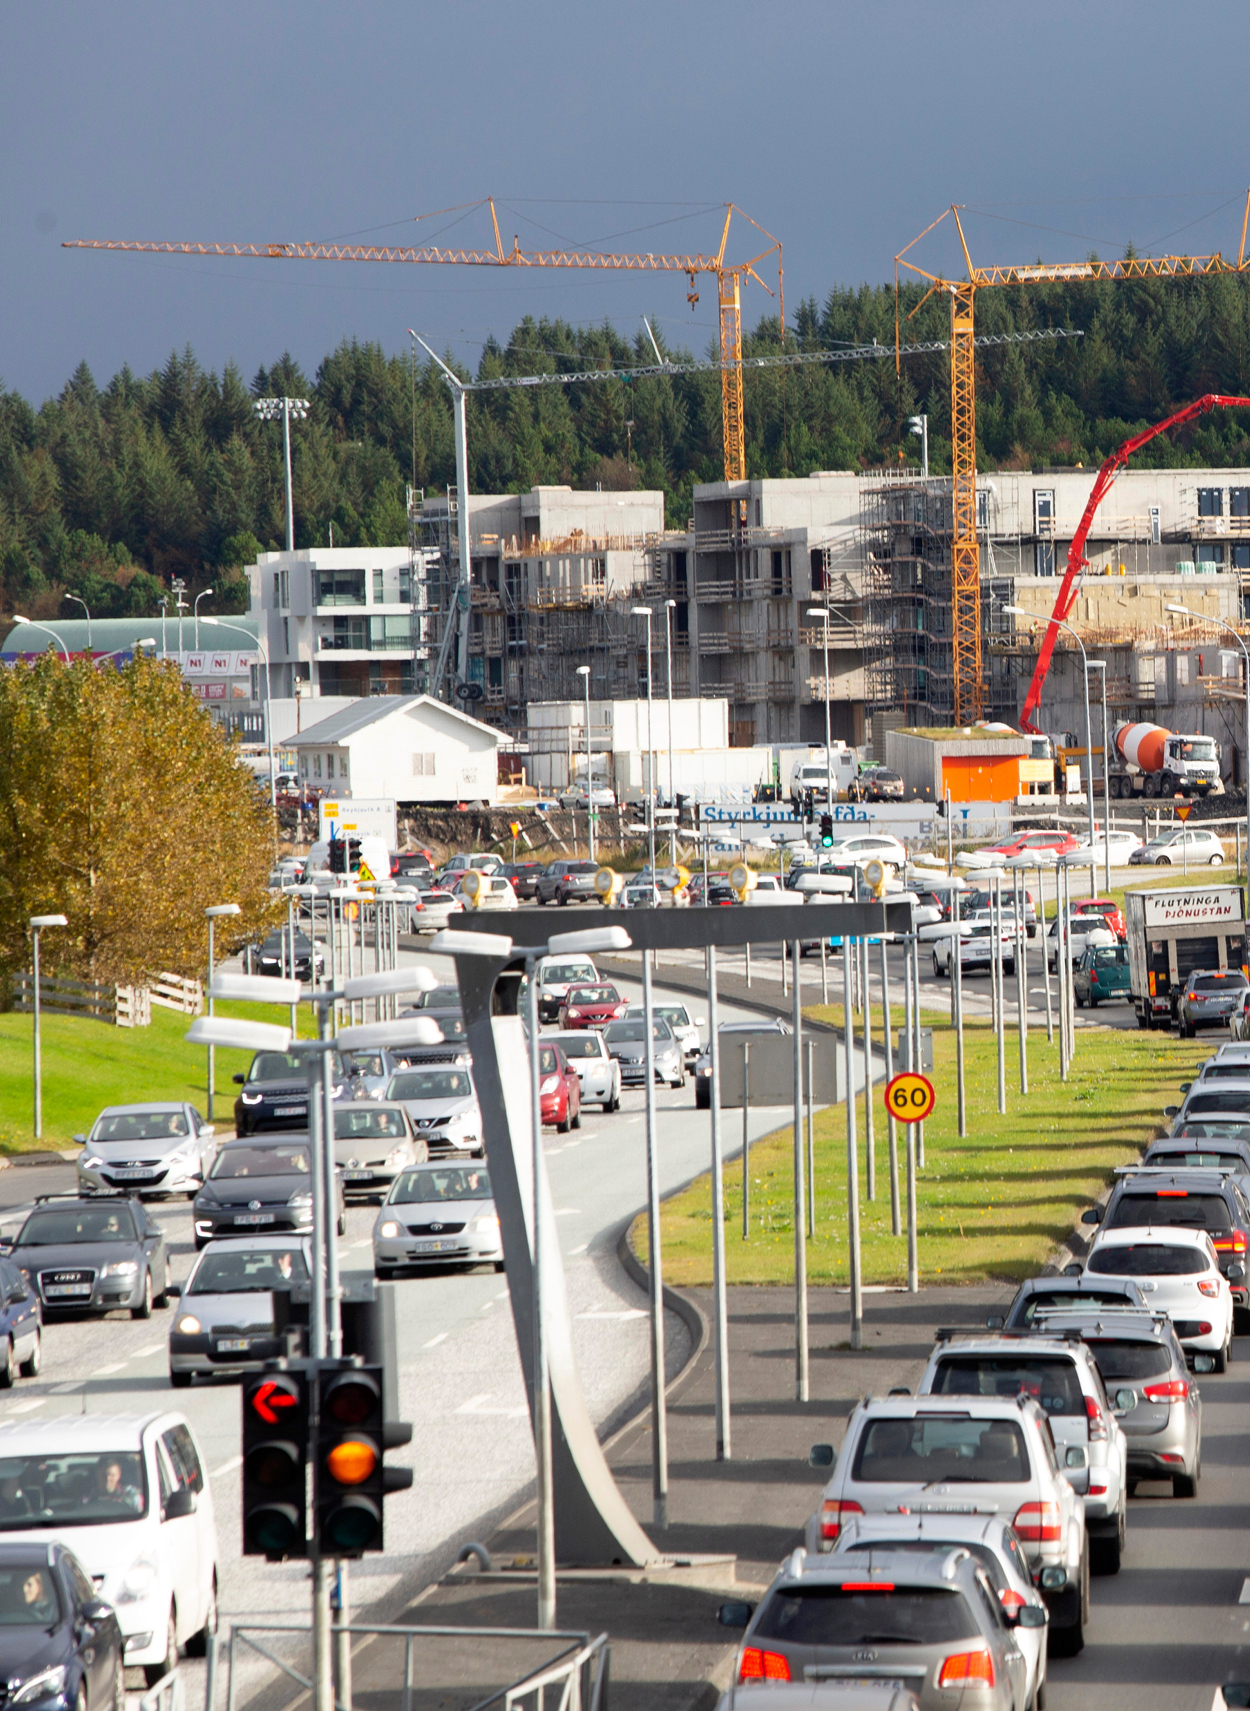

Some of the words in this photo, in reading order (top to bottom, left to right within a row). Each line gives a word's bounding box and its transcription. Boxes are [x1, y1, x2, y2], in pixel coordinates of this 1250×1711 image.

[189, 659, 201, 667] N1
[214, 659, 226, 667] N1
[814, 805, 876, 821] fða-
[1154, 896, 1220, 908] FLUTNINGA
[1165, 906, 1232, 918] ÞJÓNUSTAN
[893, 1087, 927, 1107] 60
